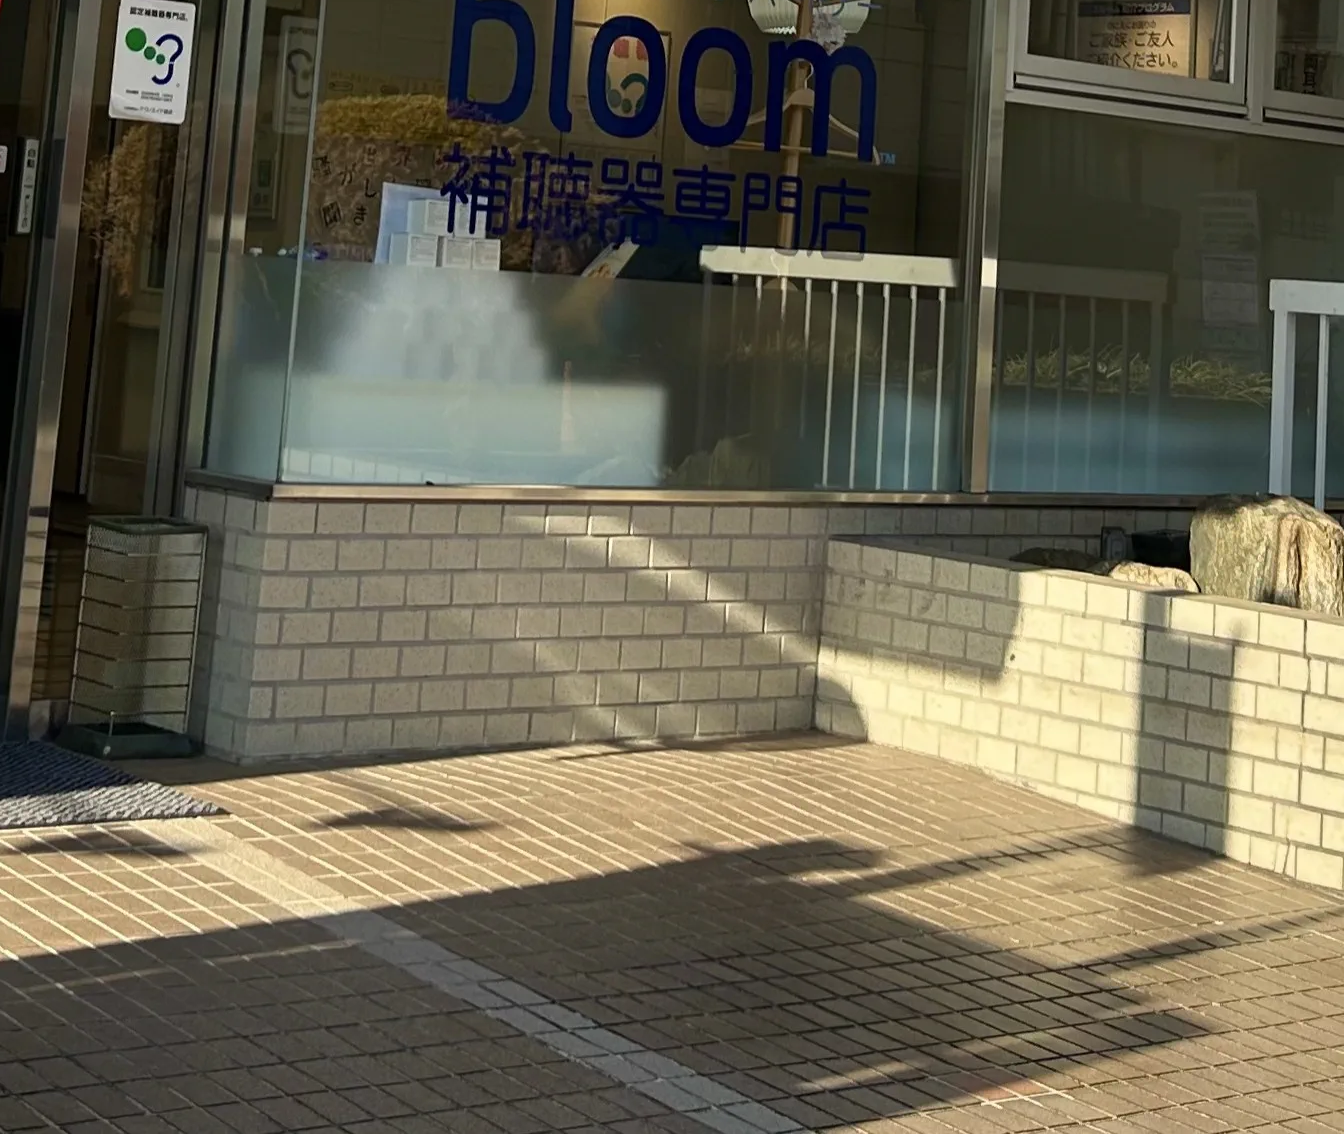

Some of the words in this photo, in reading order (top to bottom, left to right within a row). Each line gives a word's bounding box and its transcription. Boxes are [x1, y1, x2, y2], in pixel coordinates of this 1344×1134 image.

[440, 144, 871, 261] 補聴器専門店
